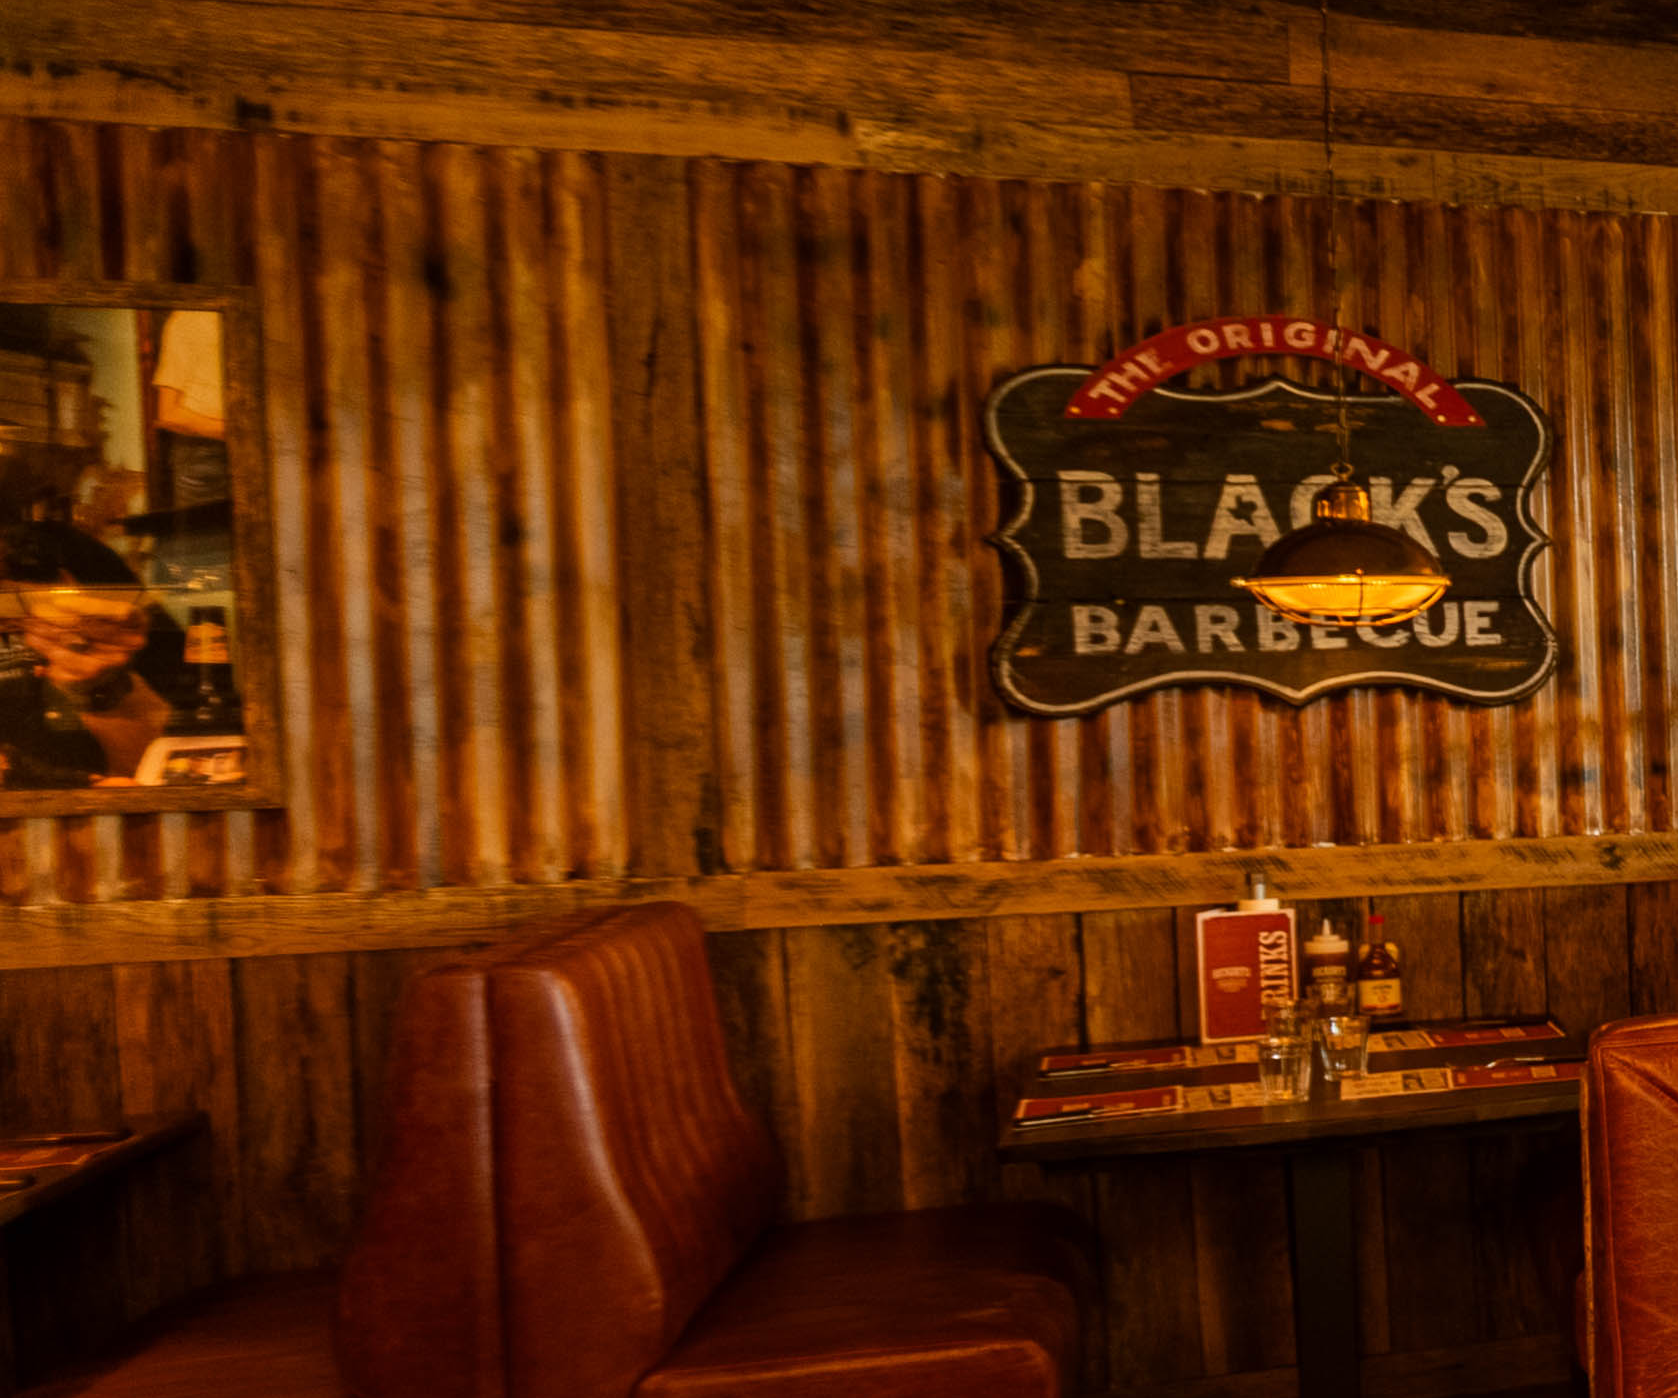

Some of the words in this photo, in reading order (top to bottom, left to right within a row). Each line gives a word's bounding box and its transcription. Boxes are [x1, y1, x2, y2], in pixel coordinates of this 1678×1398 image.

[1087, 347, 1176, 406] THE
[1186, 321, 1443, 410] ORIGINAL
[1259, 931, 1290, 1020] RINKS
